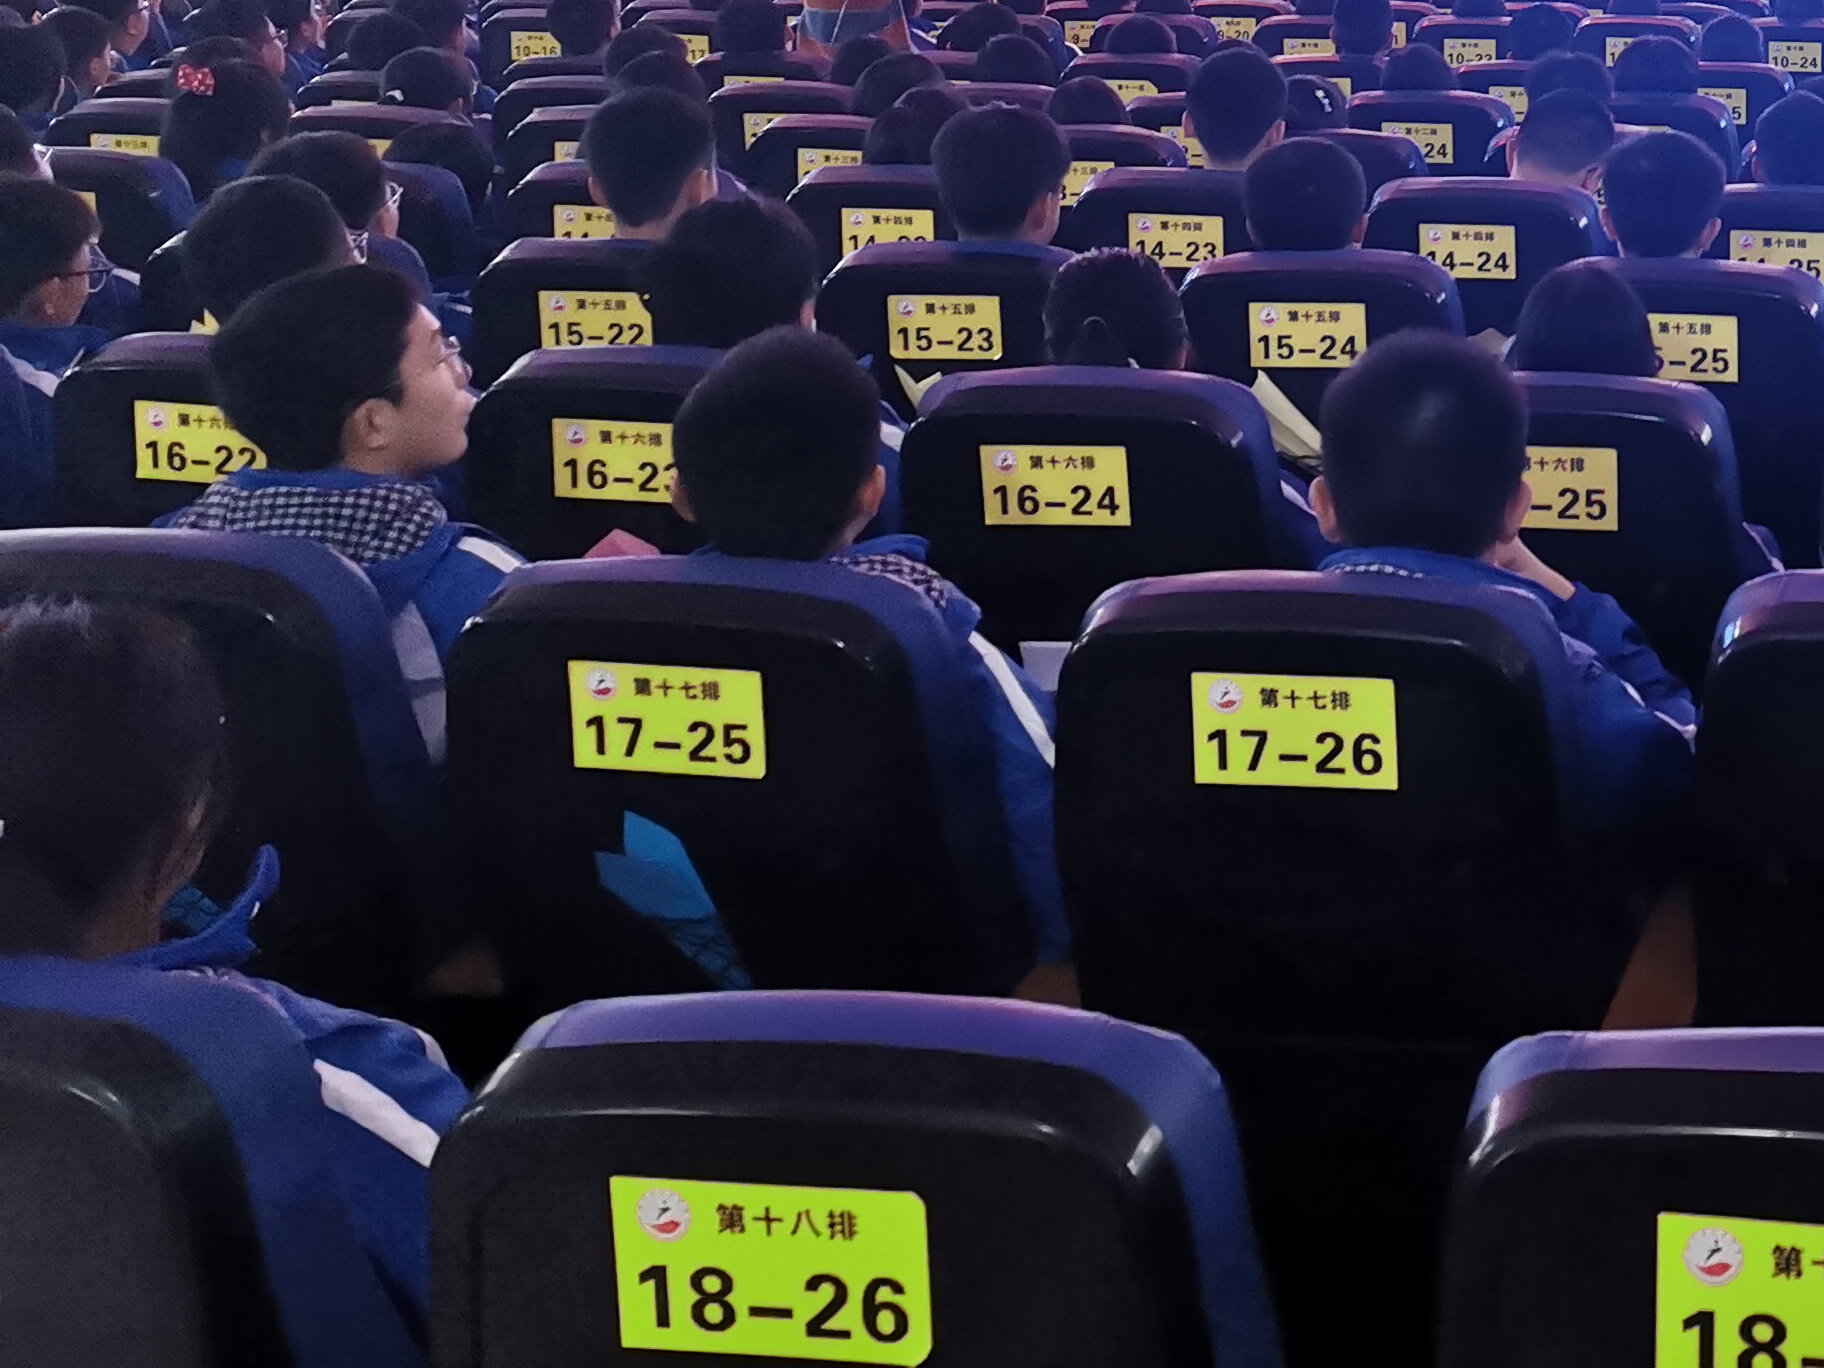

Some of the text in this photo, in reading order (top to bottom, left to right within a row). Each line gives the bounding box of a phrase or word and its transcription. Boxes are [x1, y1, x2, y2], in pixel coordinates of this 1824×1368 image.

[1772, 56, 1818, 69] 10-24
[1136, 239, 1217, 262] 14-23
[1426, 250, 1510, 273] 14-24
[547, 322, 645, 346] 15-22
[896, 327, 995, 353] 15-23
[1257, 334, 1358, 360] 15-24
[1653, 347, 1730, 374] 5-25
[145, 440, 257, 476] 16-22
[991, 485, 1121, 517] 16-24
[633, 676, 721, 702] 第十七排
[1259, 685, 1352, 713] 第十七排
[584, 714, 753, 766] 17-25
[1205, 728, 1384, 777] 17-26
[716, 1203, 859, 1241] 第十八排
[638, 1264, 909, 1344] 18-26
